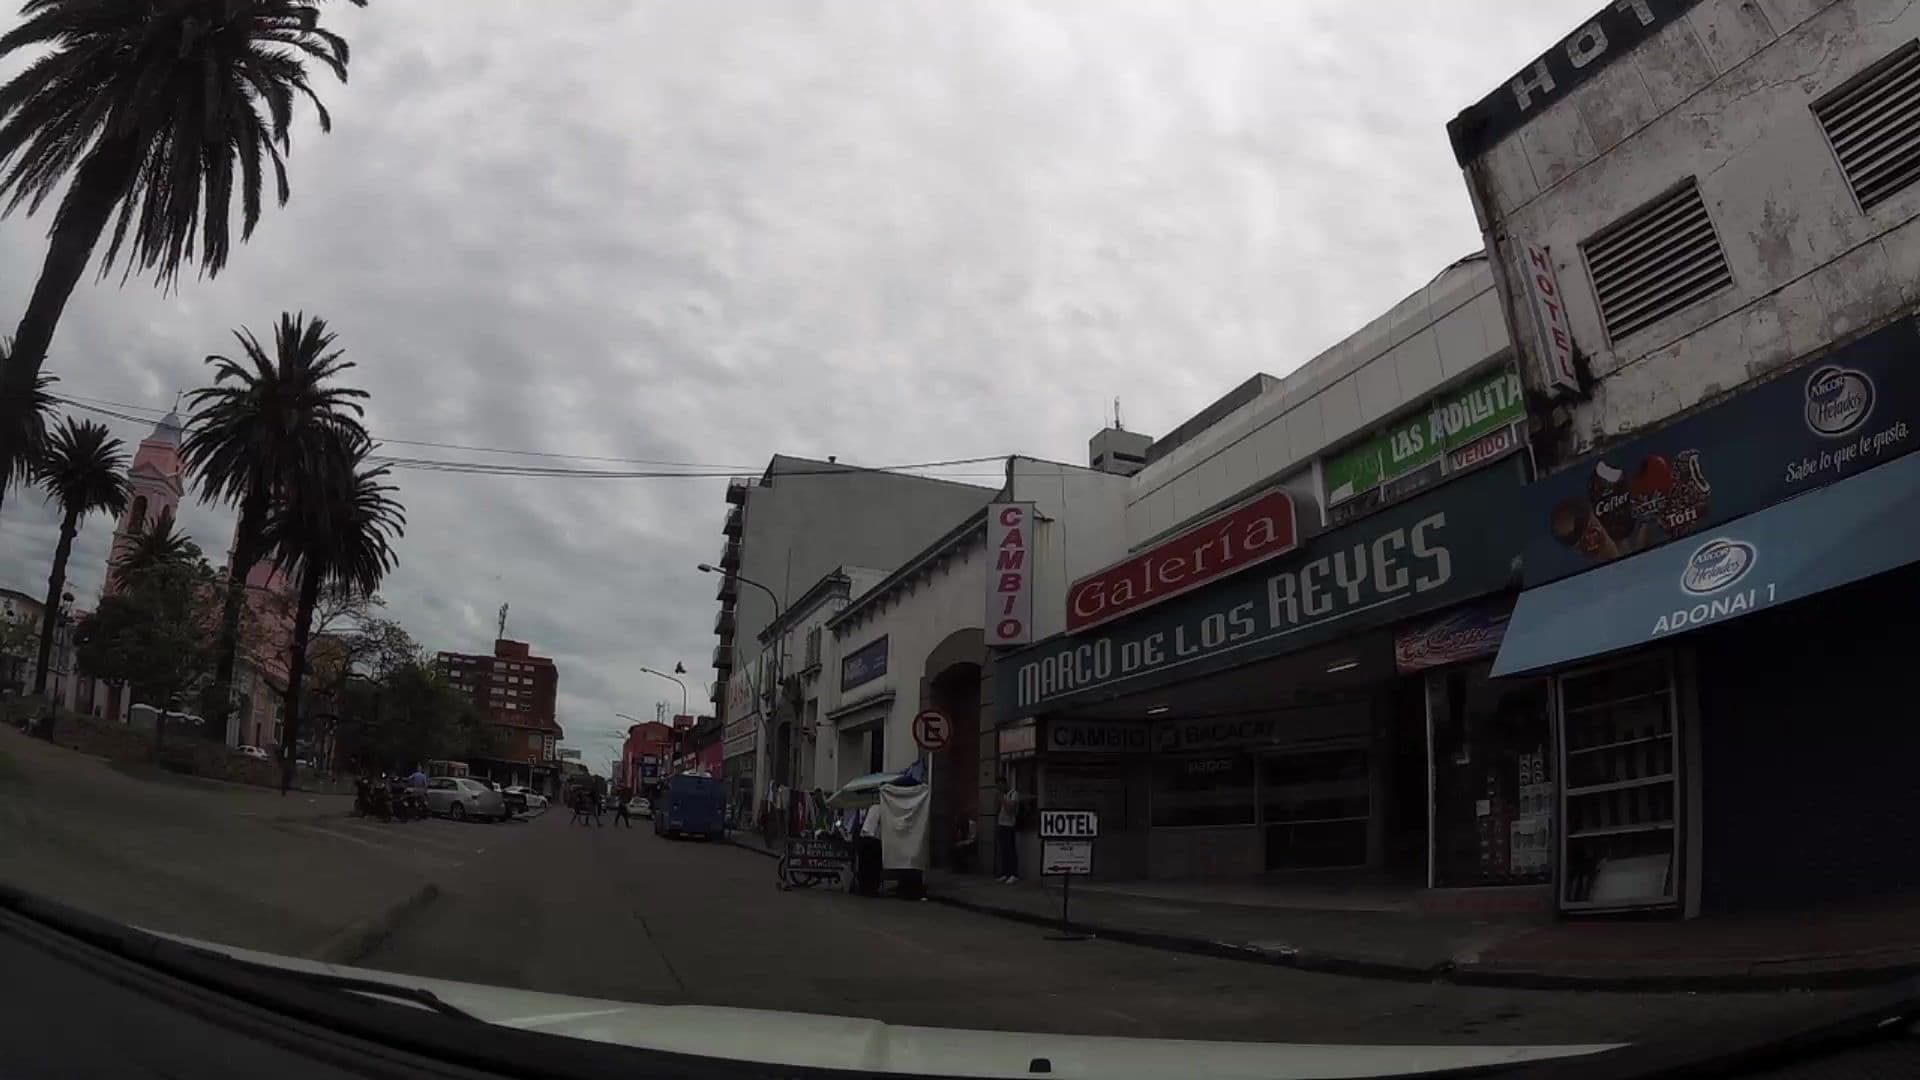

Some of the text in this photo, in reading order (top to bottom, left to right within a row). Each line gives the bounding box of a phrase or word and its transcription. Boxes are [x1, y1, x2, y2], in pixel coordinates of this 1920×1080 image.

[1528, 247, 1575, 380] HOTEL
[1390, 423, 1425, 464] LAS
[1456, 436, 1505, 466] VENDO
[1785, 457, 1817, 482] Sabe
[1819, 450, 1831, 470] lo
[1834, 443, 1857, 472] que
[1860, 434, 1872, 456] te
[996, 507, 1024, 639] CAMBIO
[1074, 516, 1279, 617] Galería
[1018, 511, 1451, 707] MARCO DE LOS REYES
[1652, 583, 1776, 635] ADONAI 1
[924, 717, 941, 741] E
[1053, 726, 1146, 747] CAMBIO
[1044, 814, 1094, 834] HOTEL
